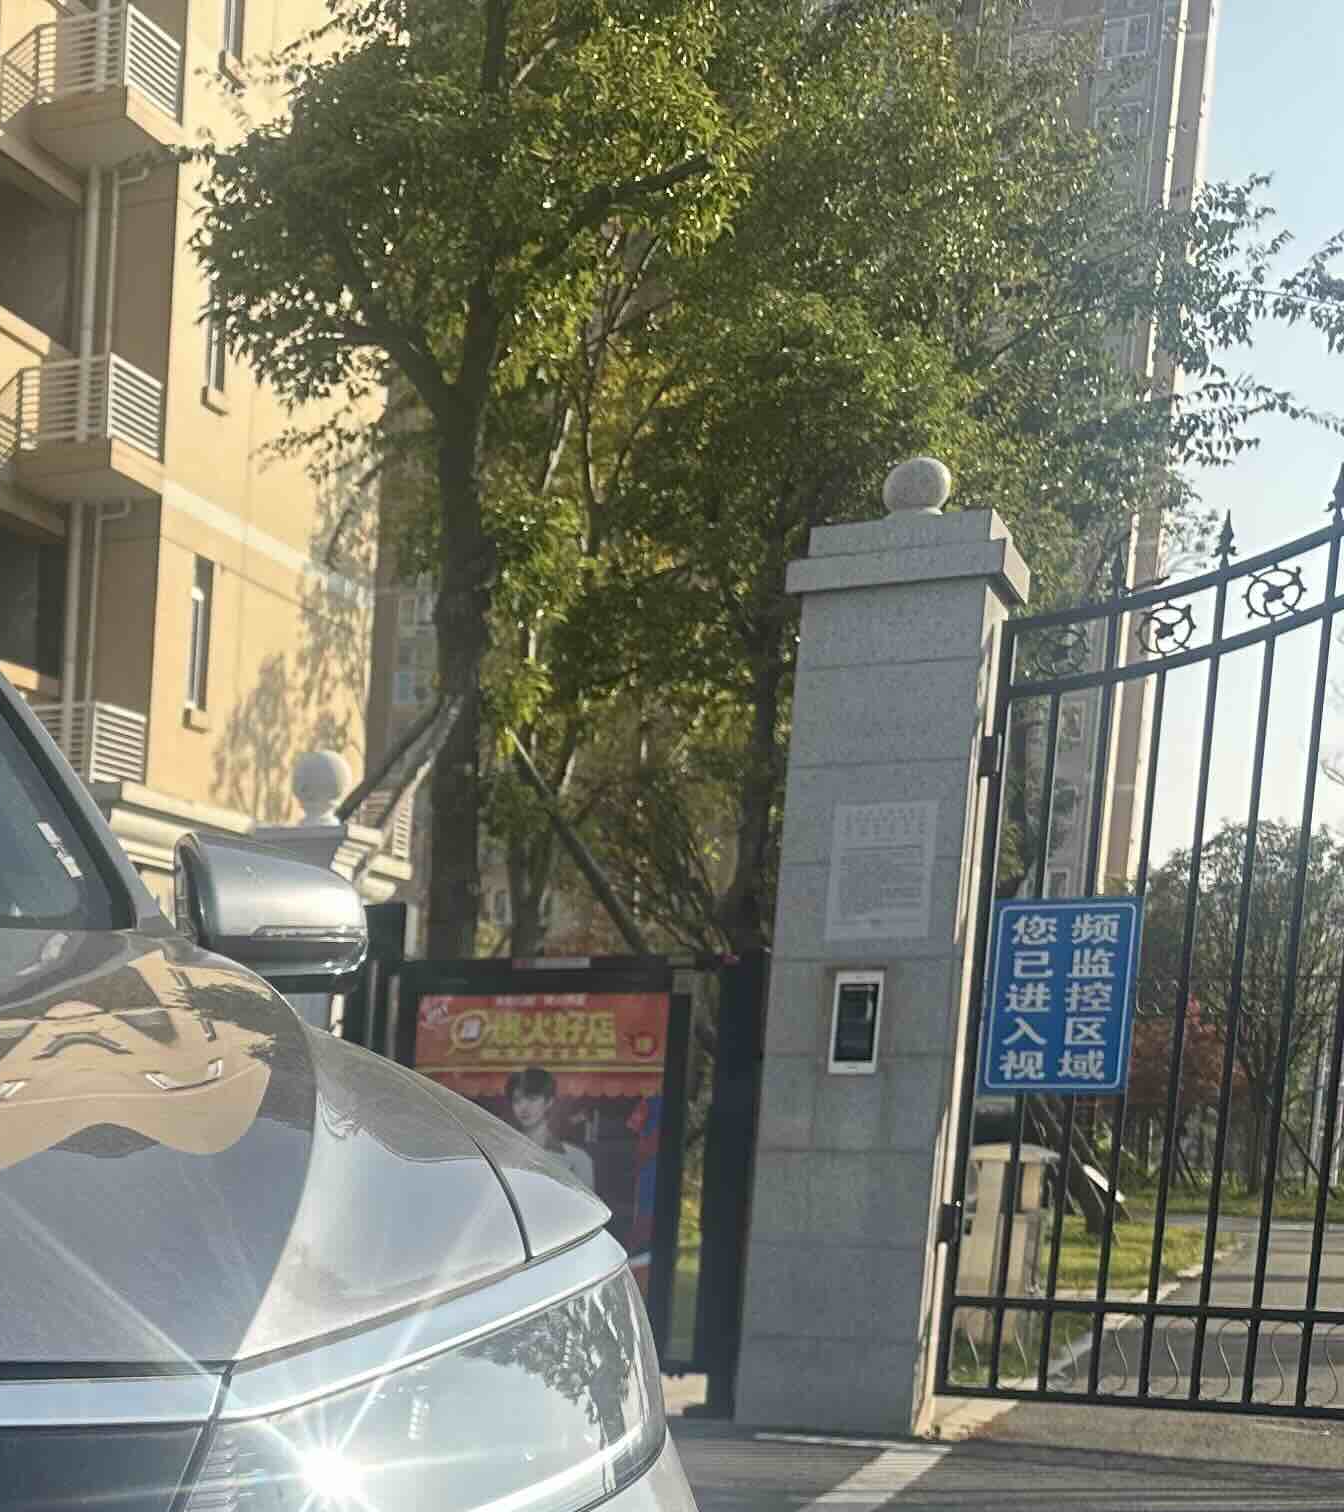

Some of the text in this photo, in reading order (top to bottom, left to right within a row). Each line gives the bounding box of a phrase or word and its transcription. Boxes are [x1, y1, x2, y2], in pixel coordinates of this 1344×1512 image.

[999, 913, 1058, 1081] 您已进入视
[1056, 913, 1121, 1081] 频监控区域
